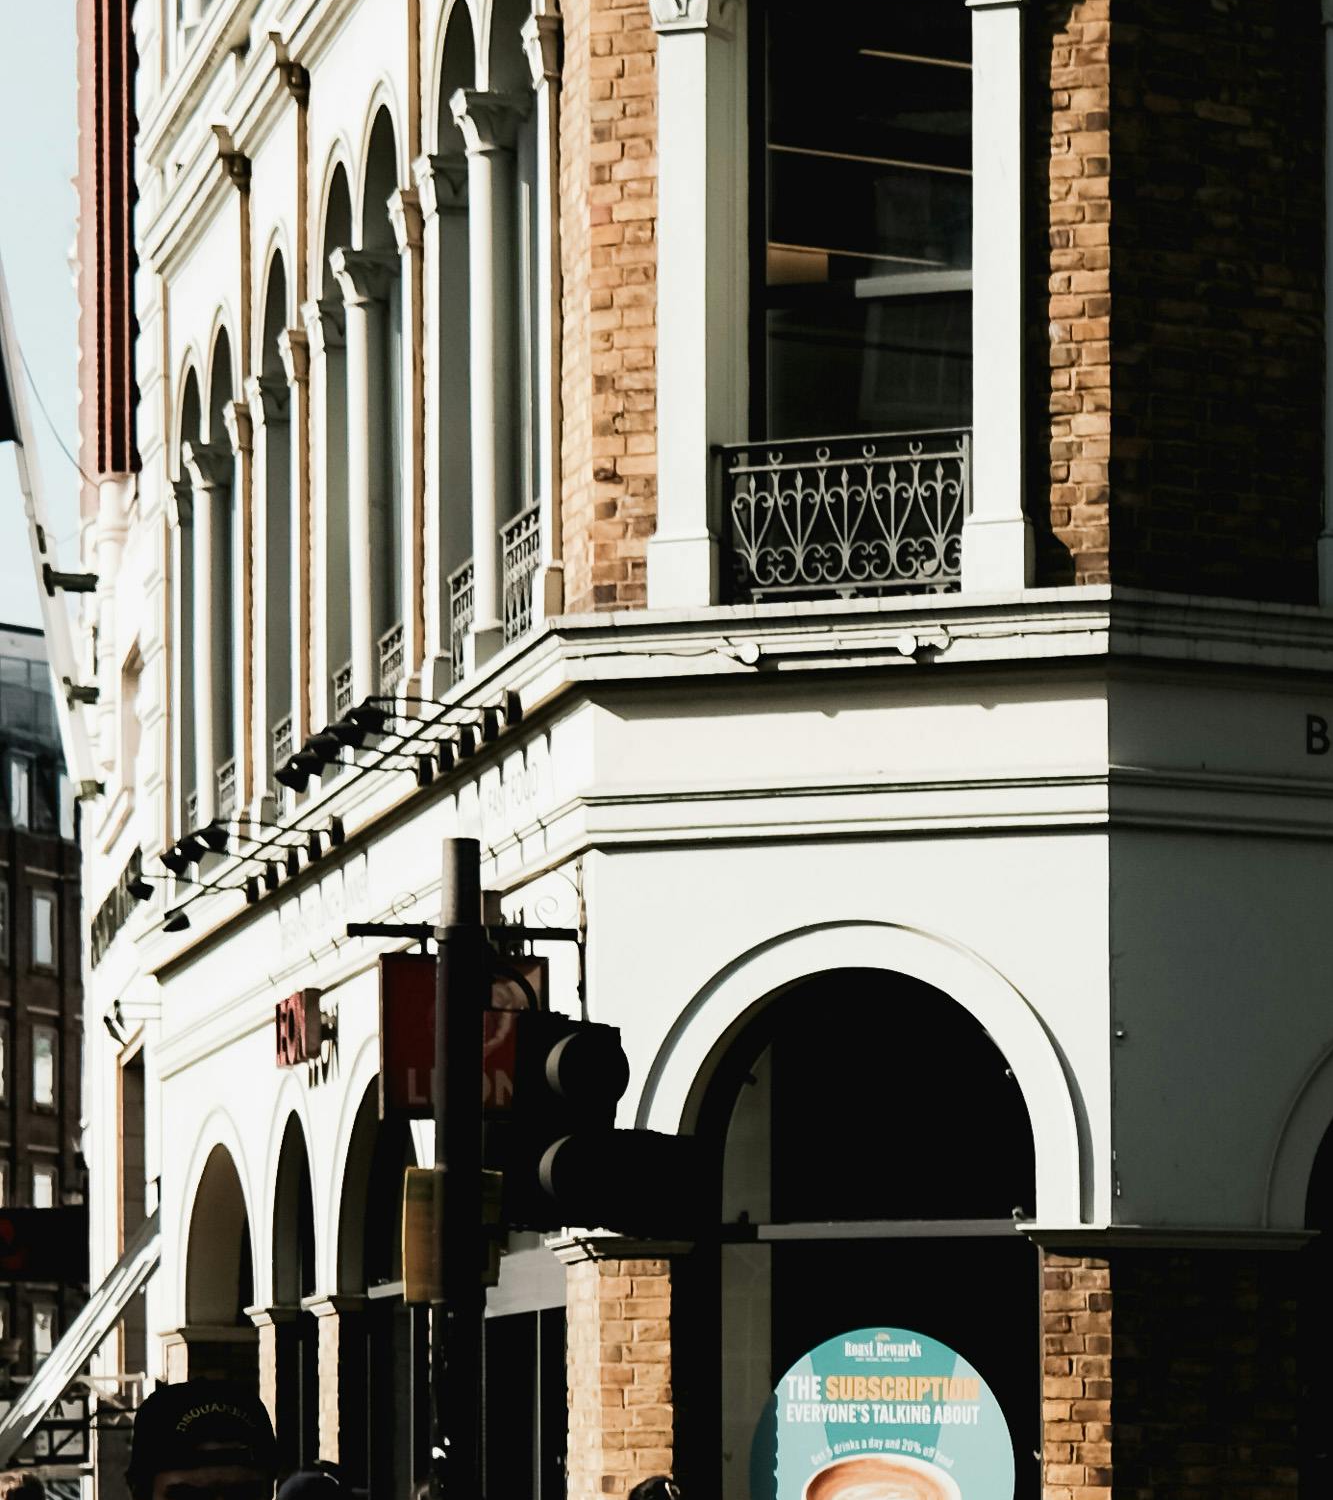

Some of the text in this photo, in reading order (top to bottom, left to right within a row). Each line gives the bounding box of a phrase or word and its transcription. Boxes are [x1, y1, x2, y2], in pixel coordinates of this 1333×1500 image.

[876, 1338, 922, 1357] Rewards
[786, 1374, 981, 1402] THE SUBSCRIPTION
[786, 1403, 981, 1425] EVERYONE'S TALKING ABOUT
[833, 1440, 860, 1454] drinks
[868, 1437, 883, 1450] day
[885, 1438, 900, 1450] and
